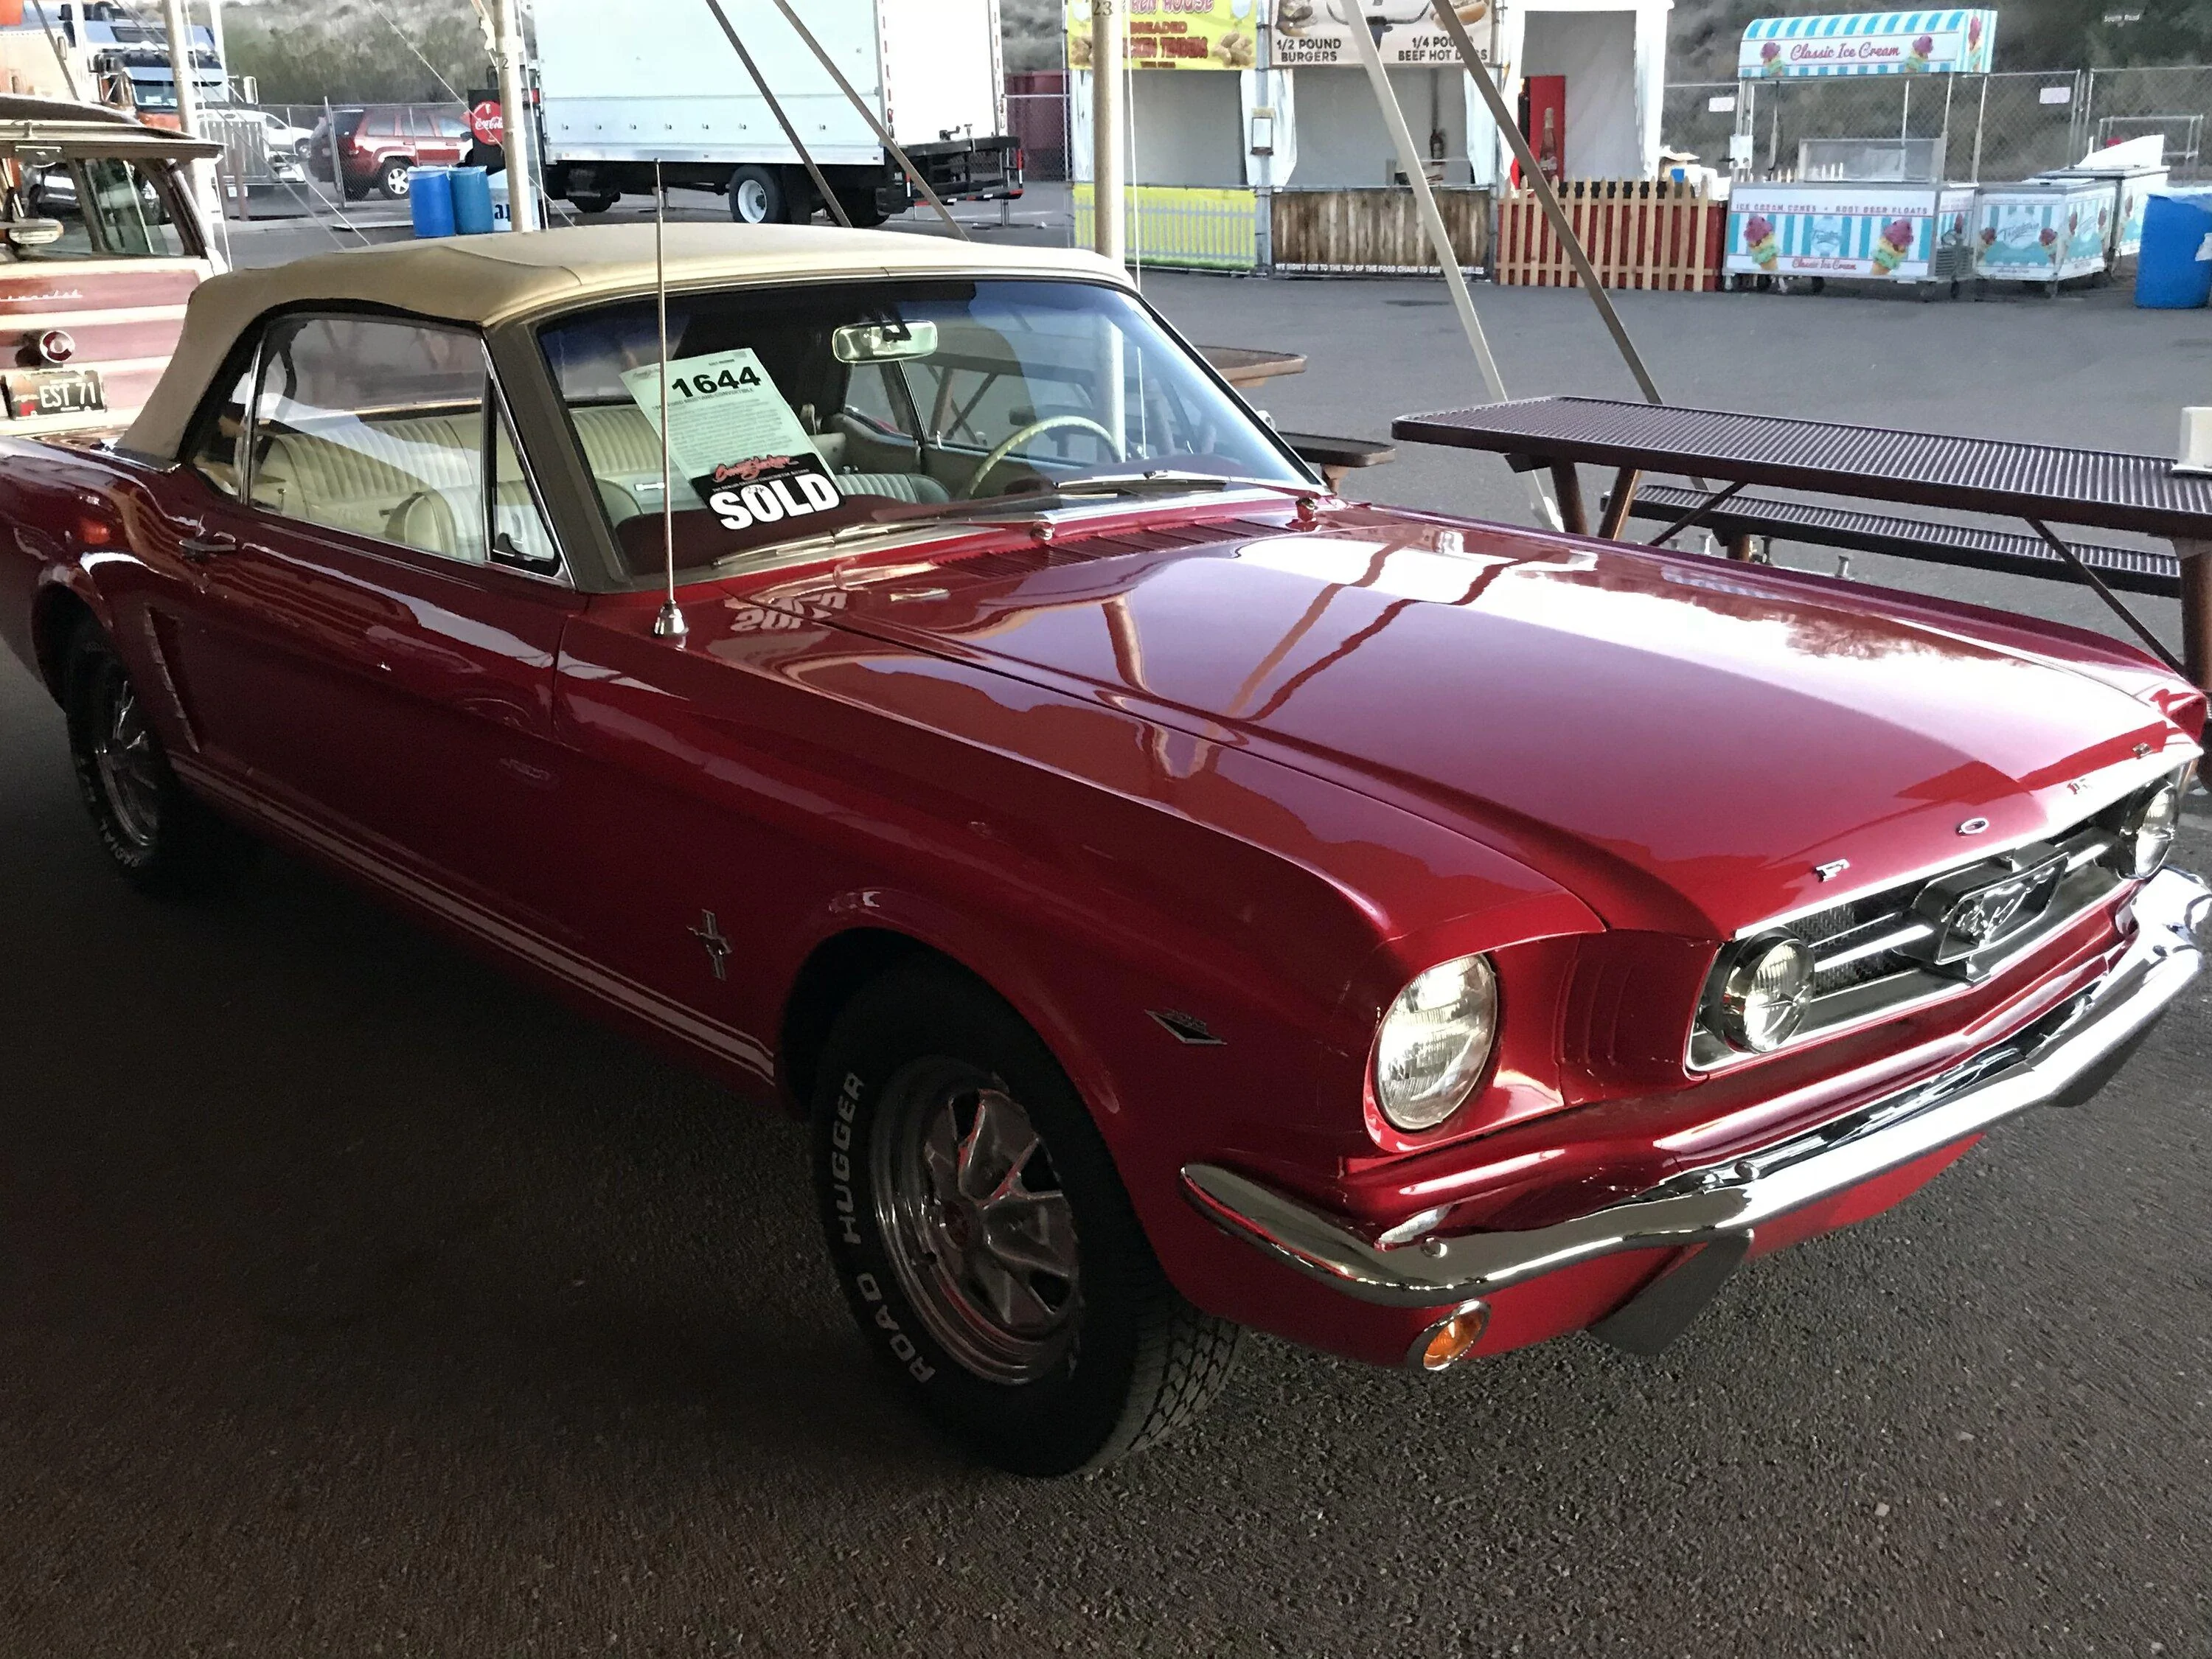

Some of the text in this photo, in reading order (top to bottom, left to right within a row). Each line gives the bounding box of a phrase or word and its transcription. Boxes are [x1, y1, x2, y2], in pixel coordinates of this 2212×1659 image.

[1276, 38, 1341, 49] 1/2 POUND
[1412, 35, 1430, 48] 1/4
[1281, 51, 1338, 62] BURGERS
[1398, 49, 1488, 61] BEEF HOT DS
[1790, 41, 1900, 61] Classic Ice Cream
[1892, 206, 1927, 215] FLOATS
[672, 366, 762, 398] 1644
[39, 382, 97, 408] EST 71
[709, 473, 840, 530] SOLD
[832, 1072, 936, 1383] ROAD HUGGER
